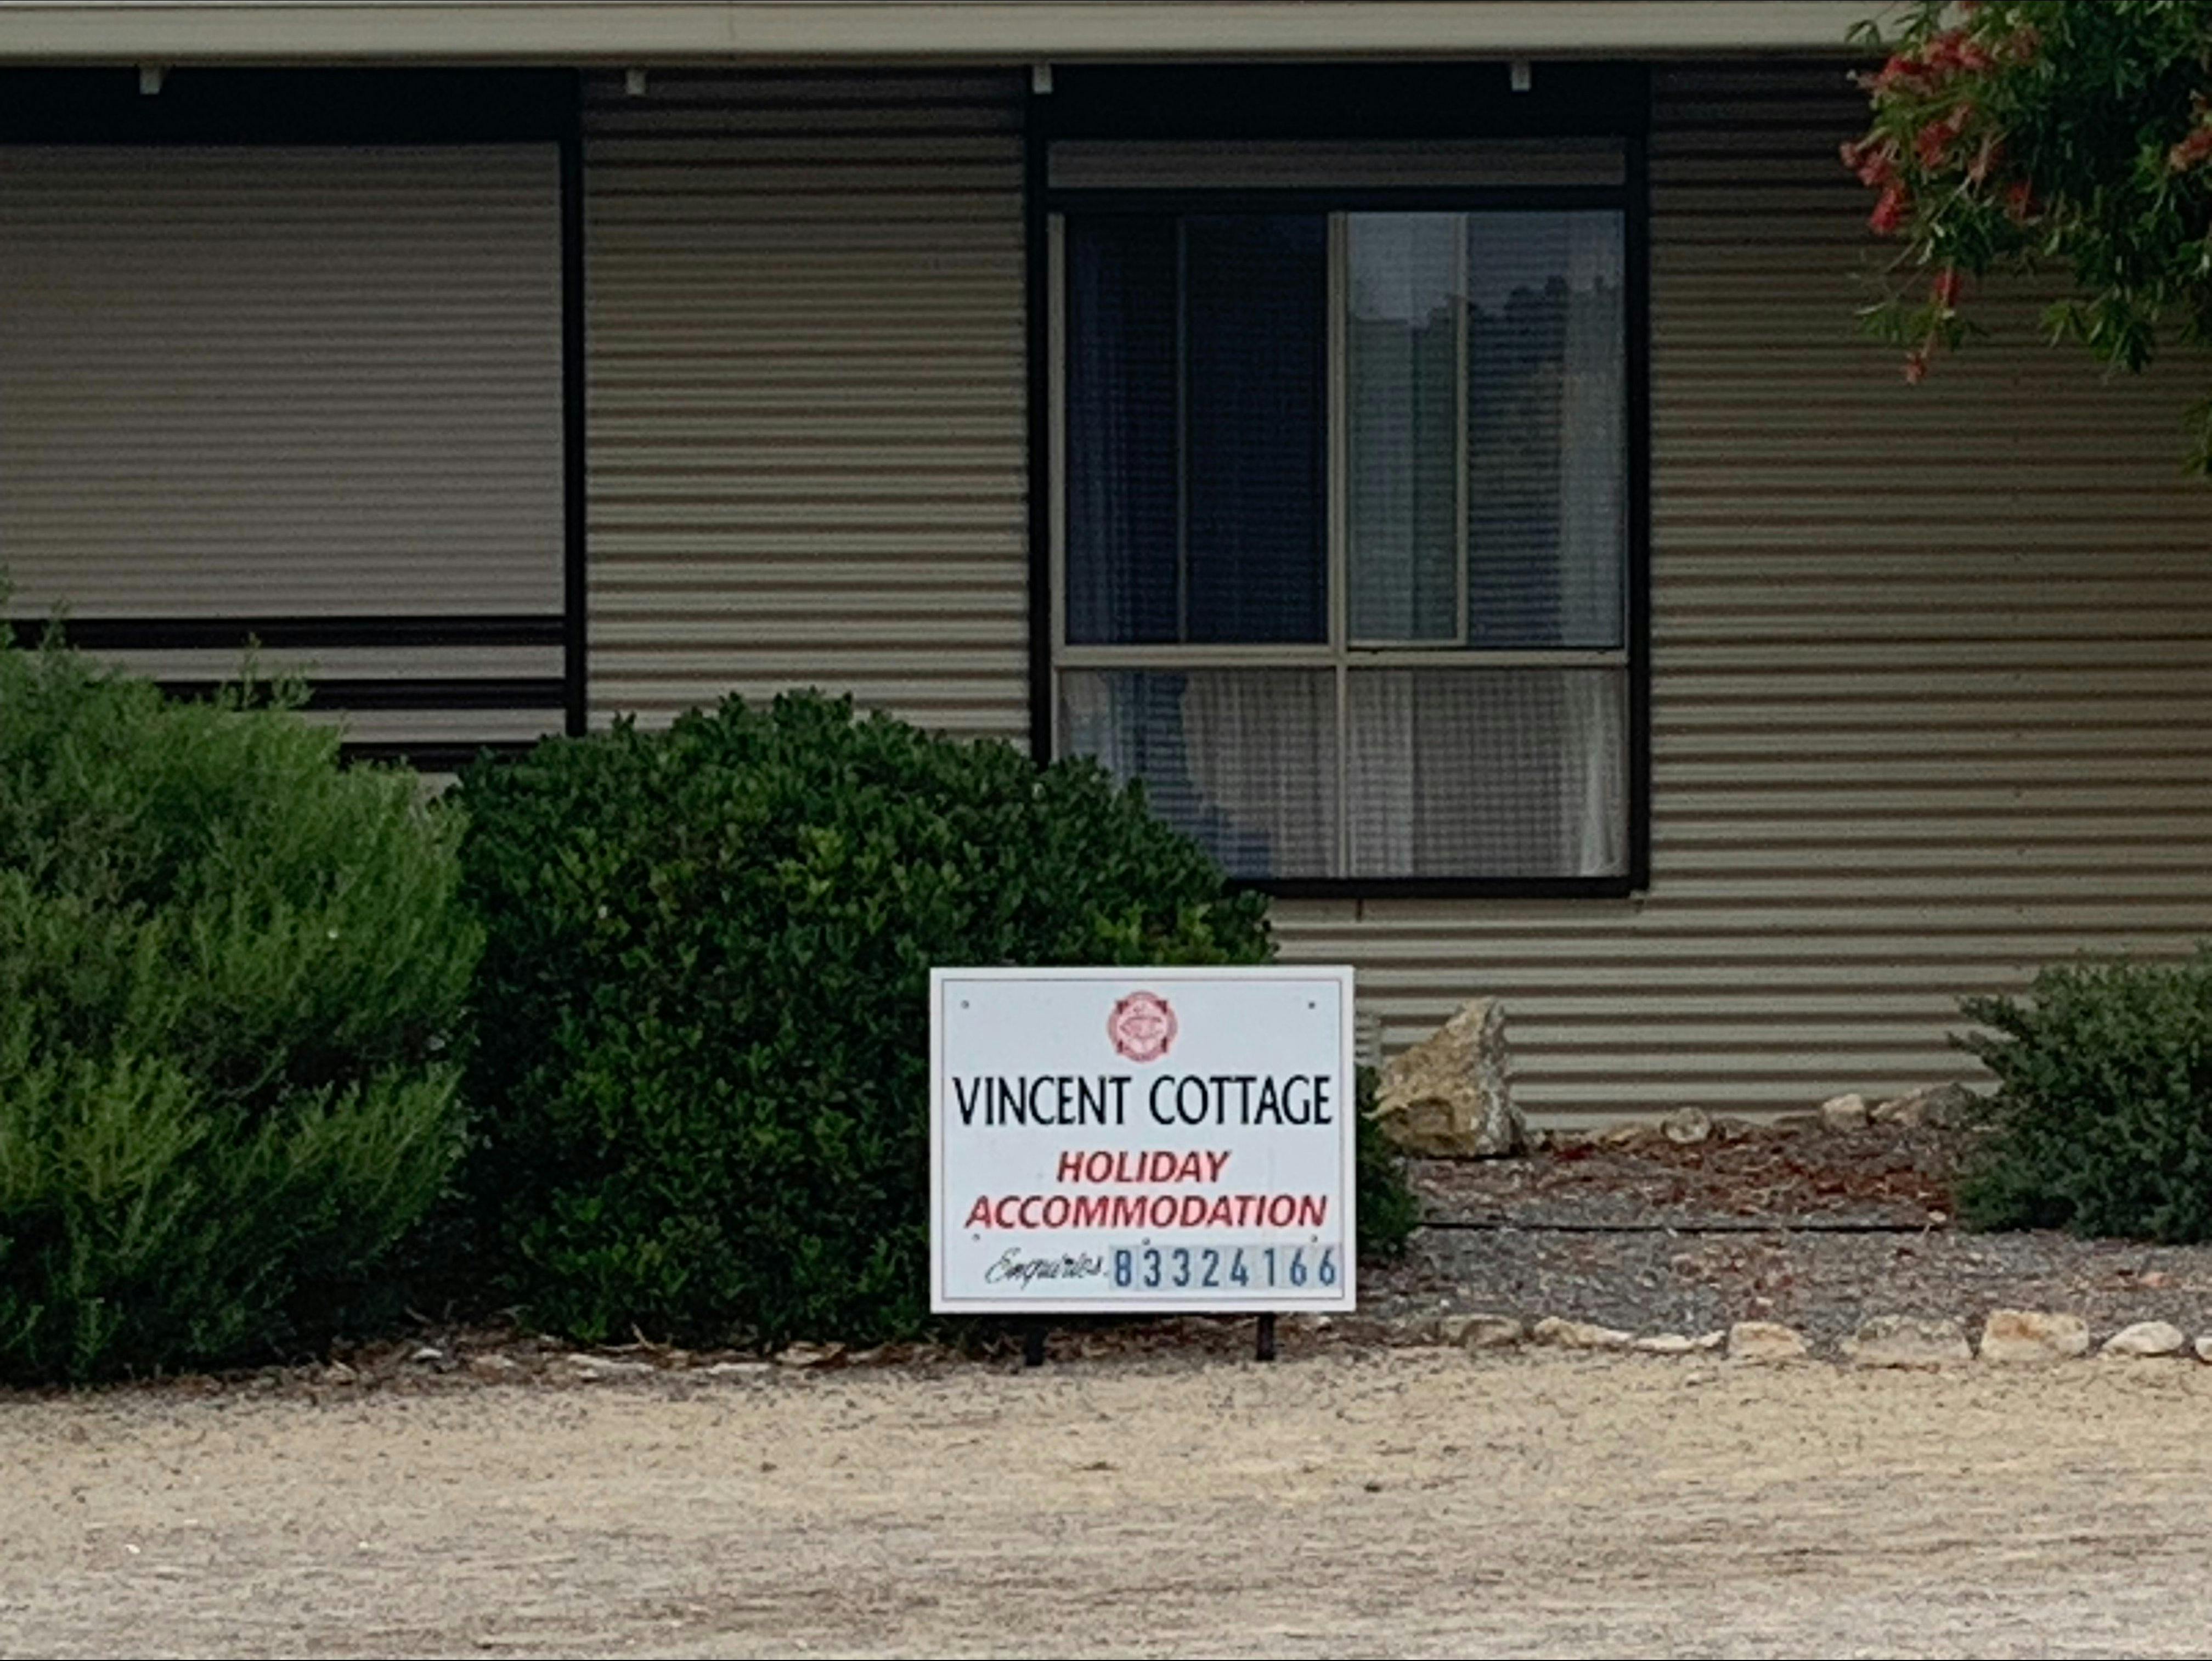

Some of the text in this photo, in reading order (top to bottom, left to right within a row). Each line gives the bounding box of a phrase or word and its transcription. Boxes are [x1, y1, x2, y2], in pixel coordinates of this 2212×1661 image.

[953, 1075, 1332, 1125] VINCENT COTTAGE
[1056, 1151, 1231, 1183] HOLIDAY
[964, 1195, 1327, 1229] ACCOMMODATION
[1114, 1248, 1336, 1287] 83324166
